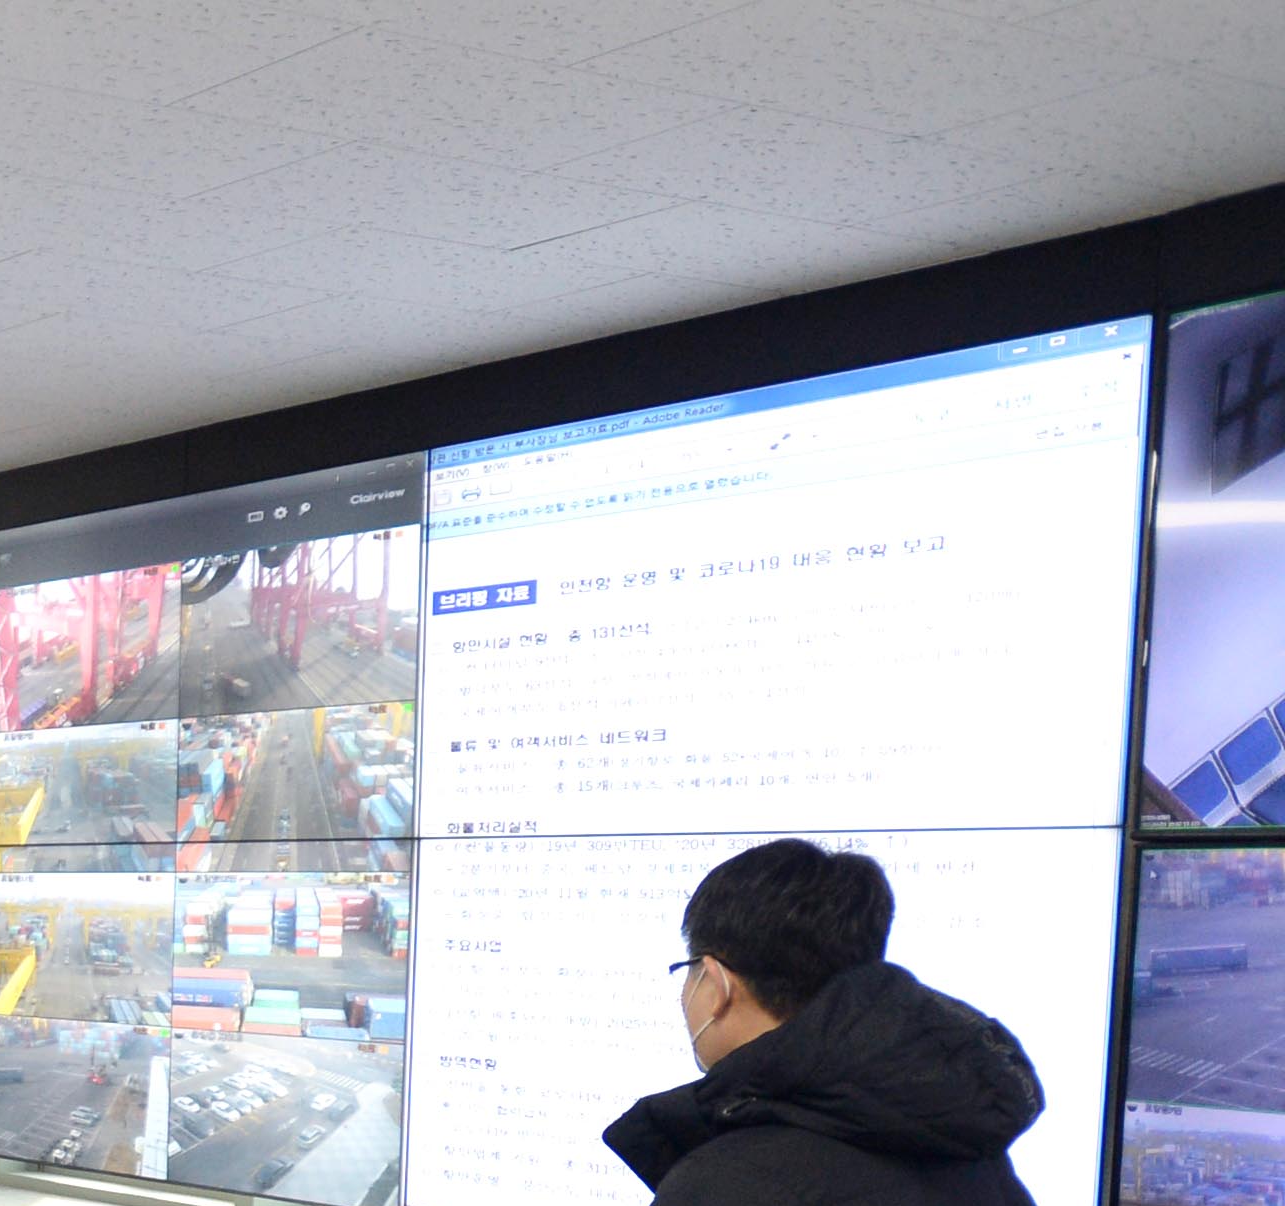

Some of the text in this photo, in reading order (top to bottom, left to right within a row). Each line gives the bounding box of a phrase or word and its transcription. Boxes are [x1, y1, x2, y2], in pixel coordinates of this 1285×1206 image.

[643, 410, 679, 426] Adobe
[684, 402, 726, 416] Reader
[350, 488, 406, 505] Clairview
[700, 555, 781, 579] 코로나19
[496, 585, 530, 603] 자료
